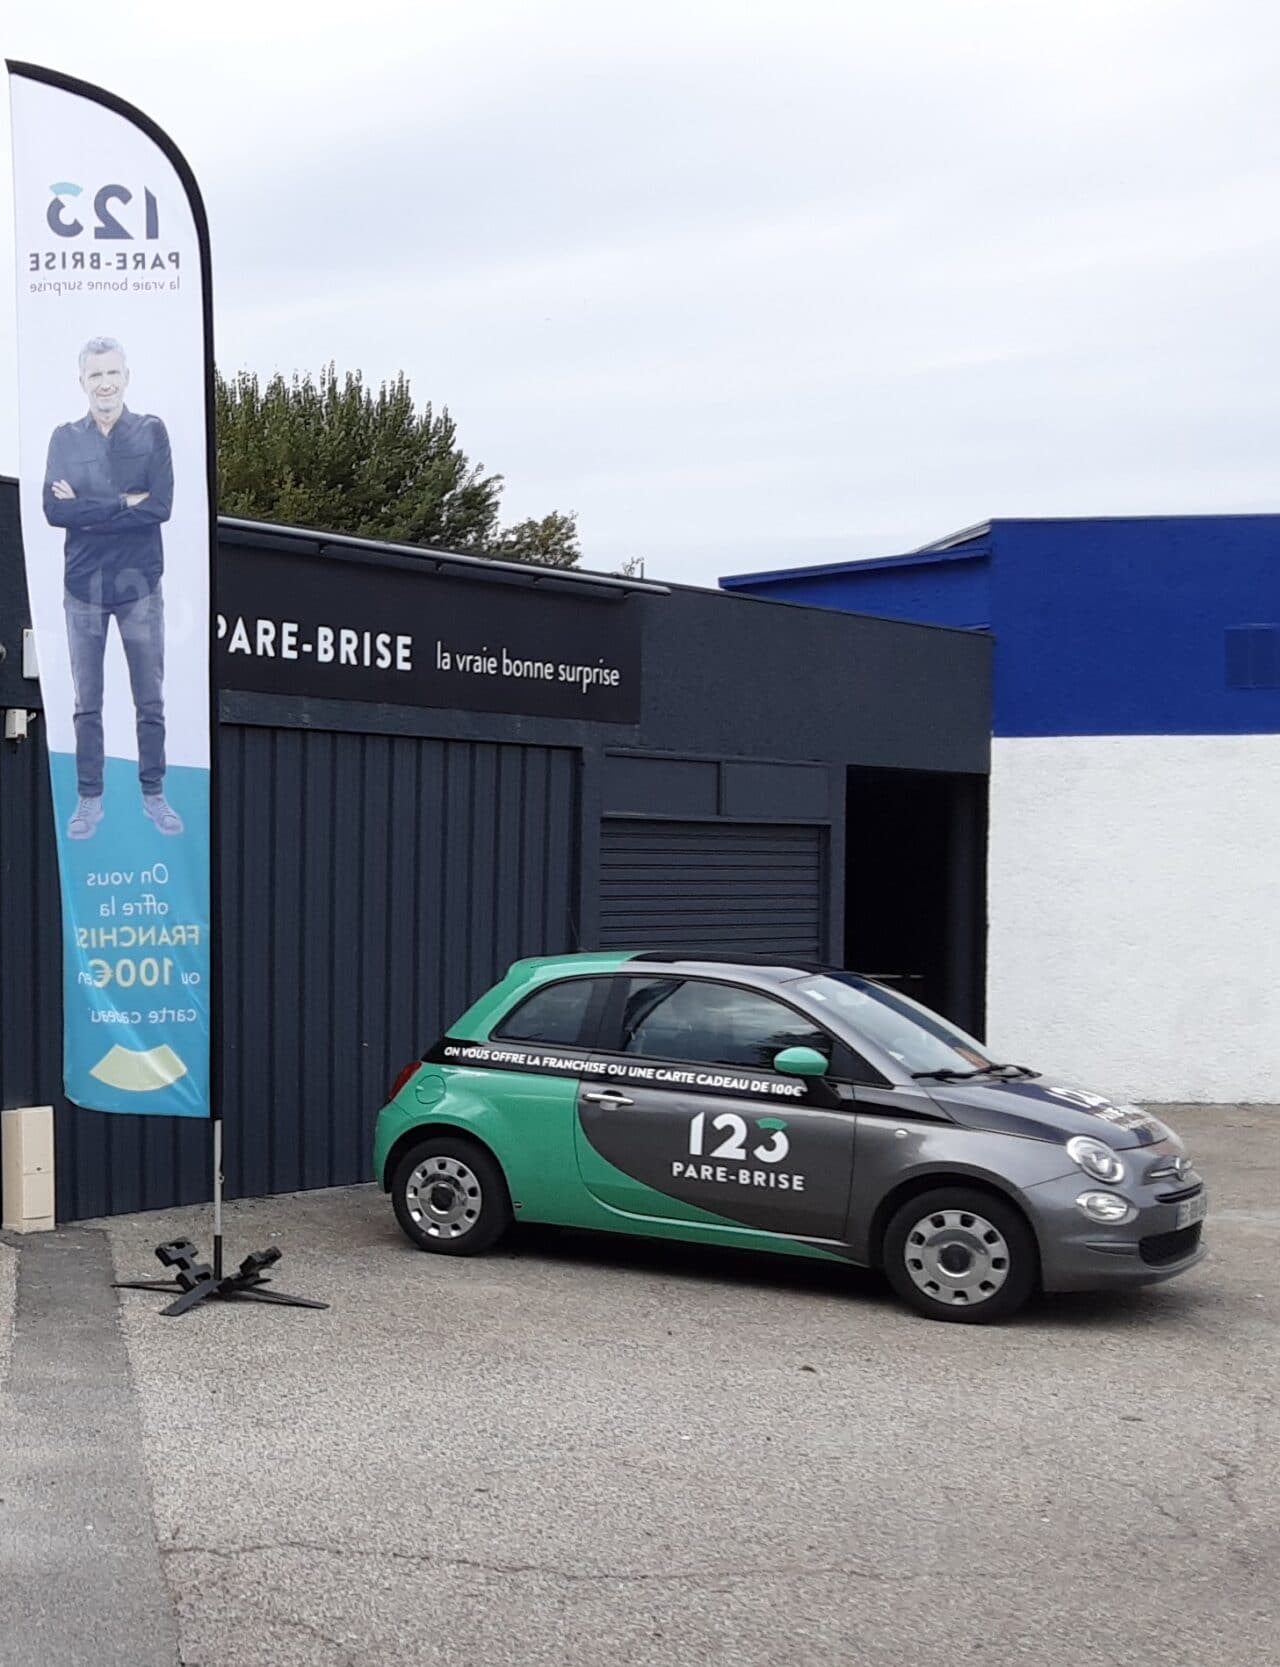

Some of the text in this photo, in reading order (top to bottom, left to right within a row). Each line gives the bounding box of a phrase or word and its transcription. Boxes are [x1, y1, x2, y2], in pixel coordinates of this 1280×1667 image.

[436, 640, 621, 694] la vraie bonne surprise
[444, 1046, 460, 1057] ON
[462, 1047, 491, 1061] VOUS
[491, 1051, 526, 1065] OFFRE
[526, 1054, 541, 1067] LA
[542, 1056, 607, 1074] FRANCHISE
[607, 1063, 626, 1076] OU
[627, 1066, 654, 1080] UNE
[655, 1069, 695, 1084] CARTE
[696, 1073, 749, 1090] CADEAU
[750, 1081, 770, 1094] DE
[689, 1111, 790, 1164] 123
[671, 1161, 806, 1192] PARE-BRISE
